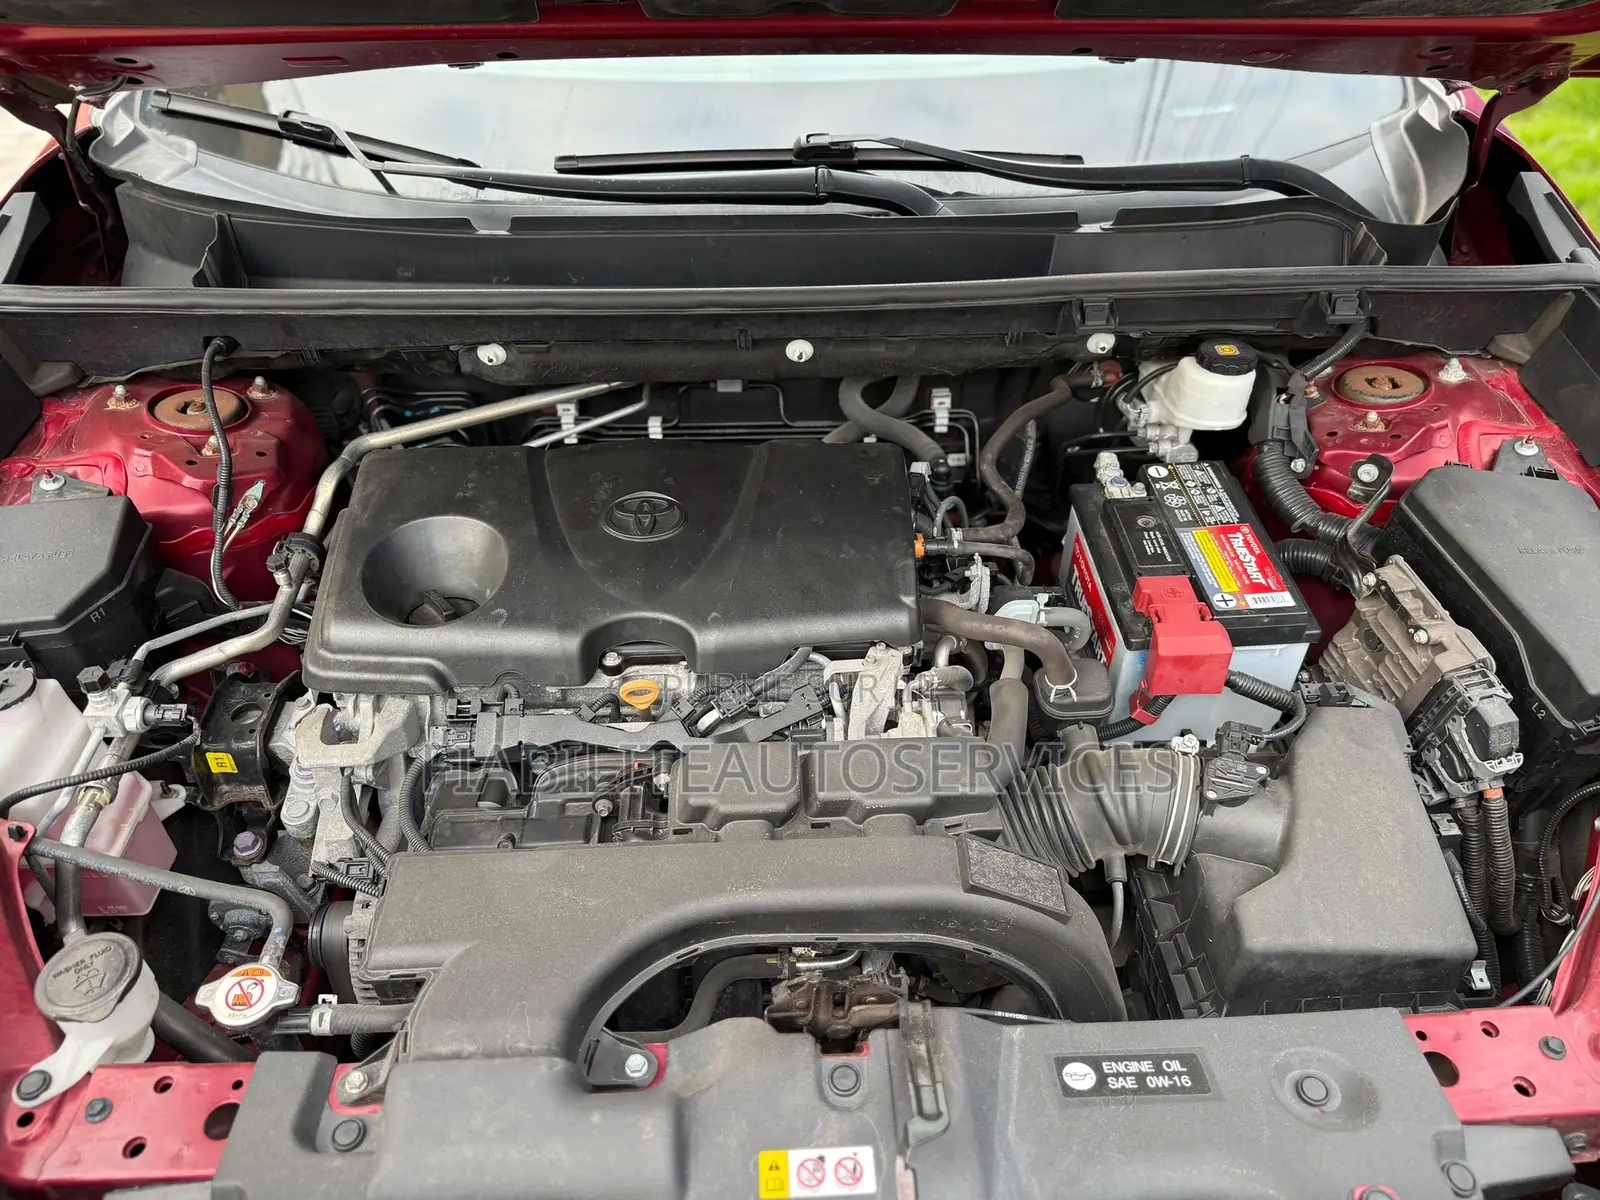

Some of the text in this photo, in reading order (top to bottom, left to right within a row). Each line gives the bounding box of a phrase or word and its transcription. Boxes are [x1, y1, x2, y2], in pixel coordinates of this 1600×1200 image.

[1246, 533, 1261, 554] TOYOTA
[90, 607, 106, 623] R1
[1531, 702, 1546, 720] L2
[52, 945, 112, 979] WASHER FLUID
[74, 960, 94, 974] ONLY
[1102, 1059, 1187, 1073] ENGINE OIL
[1107, 1075, 1192, 1089] SAE 0W-16
